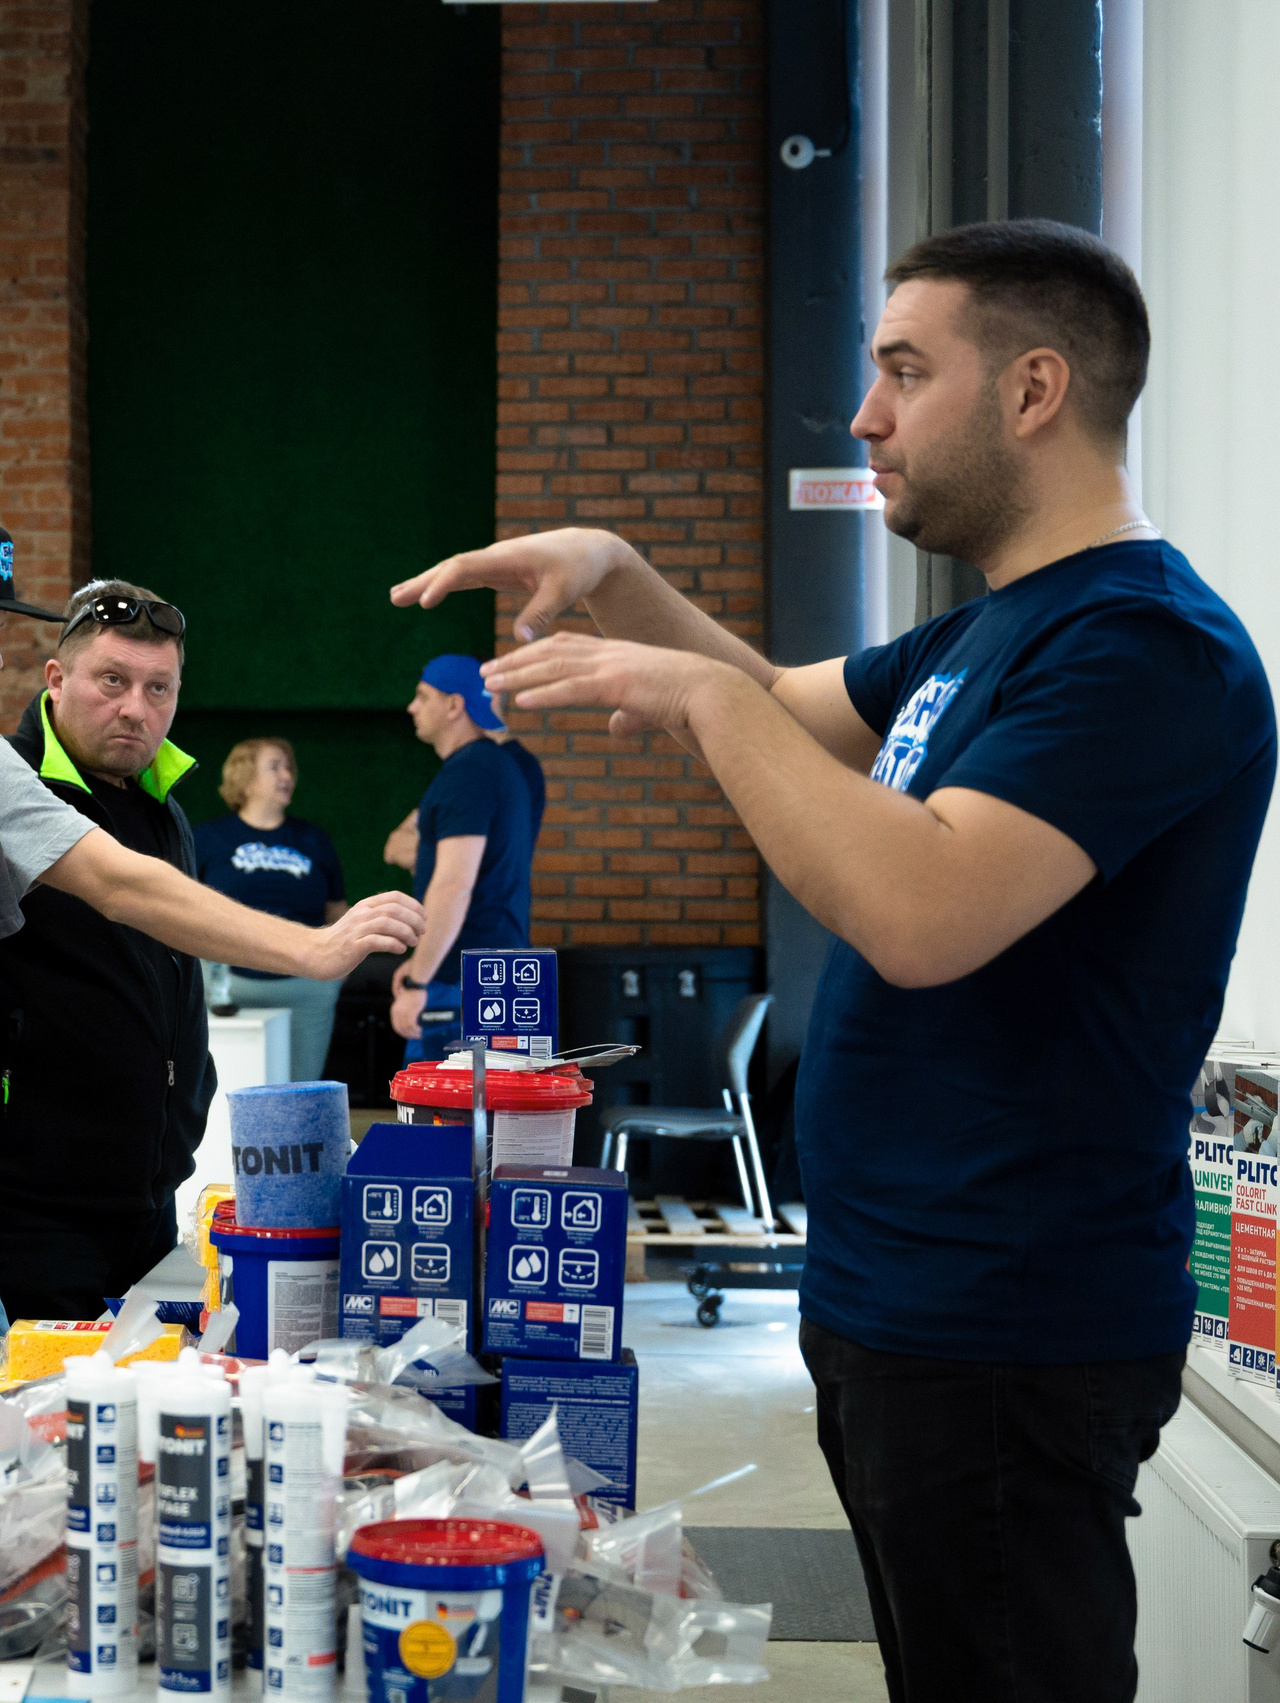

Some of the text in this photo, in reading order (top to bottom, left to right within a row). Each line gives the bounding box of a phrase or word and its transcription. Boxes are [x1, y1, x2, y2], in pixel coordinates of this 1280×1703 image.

[797, 482, 875, 503] ПОЖАР
[1236, 1184, 1267, 1200] COLORIT
[1236, 1197, 1278, 1216] FAST CLINK
[1235, 1222, 1276, 1239] ЦЕМЕНТНАЯ
[1245, 1349, 1252, 1363] 2
